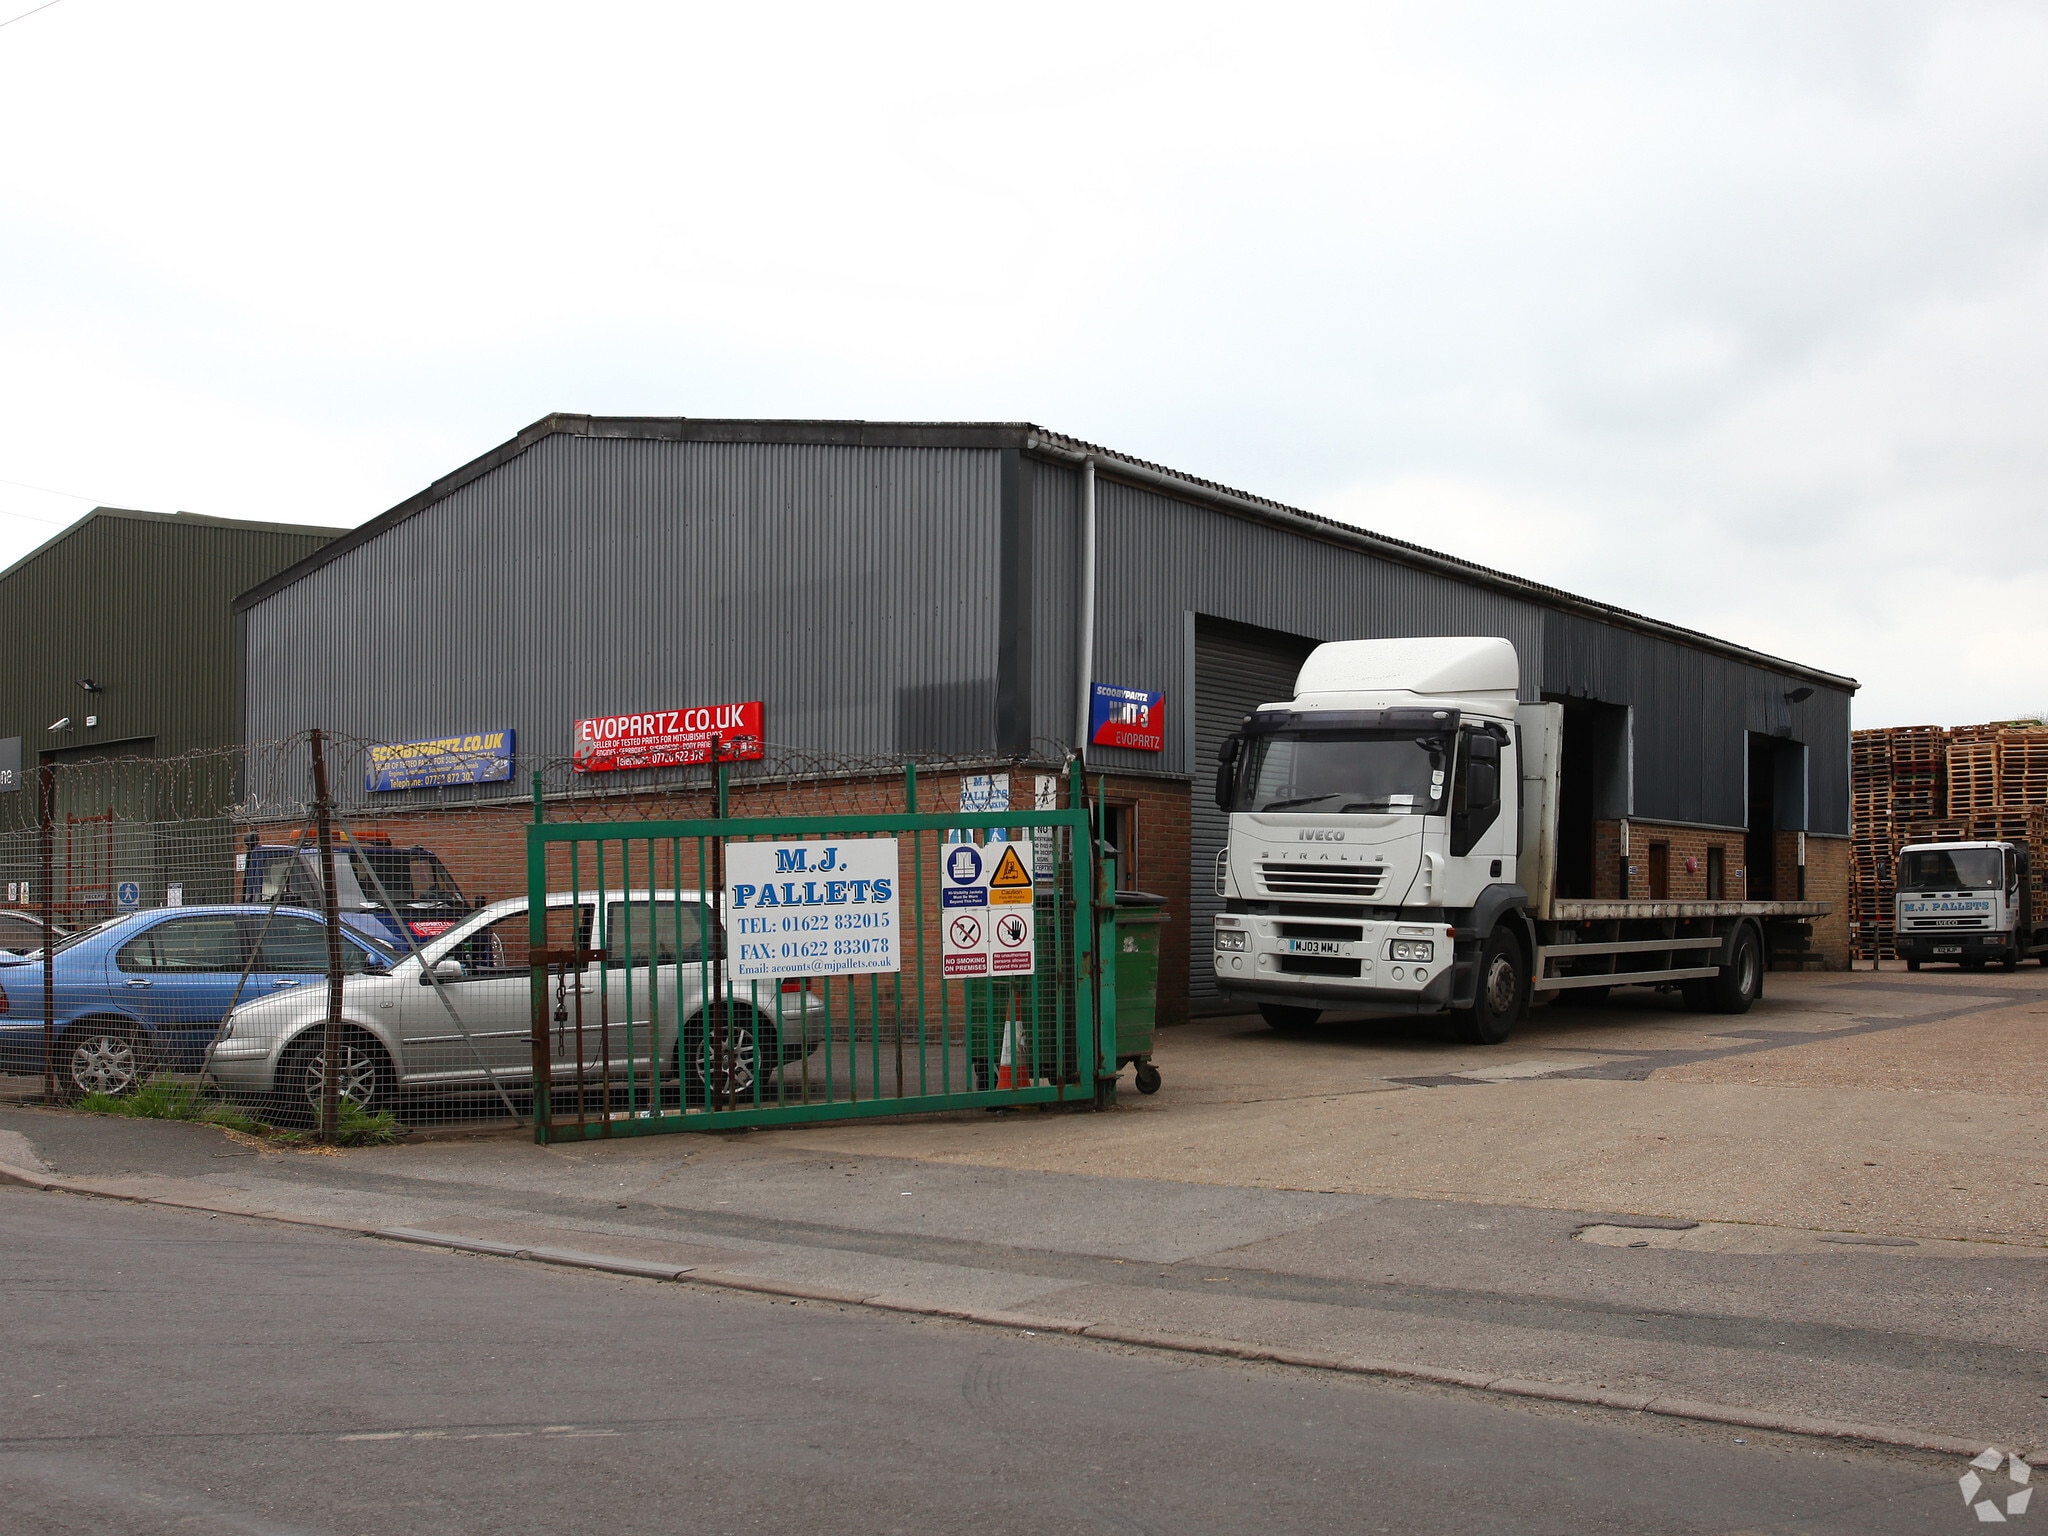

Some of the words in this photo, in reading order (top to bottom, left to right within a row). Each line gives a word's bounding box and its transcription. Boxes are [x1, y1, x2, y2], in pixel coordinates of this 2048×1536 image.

[1097, 686, 1148, 702] SCOOBYPARTZ
[582, 705, 745, 741] EVOPARTZ.CO.UK
[1109, 700, 1138, 726] UNIT
[1140, 705, 1149, 728] 3
[593, 740, 612, 749] SELLER
[612, 739, 620, 747] OF
[621, 737, 641, 747] TESTED
[641, 736, 660, 745] PARTS
[660, 734, 672, 743] FOR
[672, 732, 706, 742] MITSUBISHI
[1116, 731, 1160, 749] EVOPARTZ
[1299, 829, 1345, 841] IVECO
[775, 847, 848, 874] M.J.
[1261, 851, 1384, 862] STRALIS
[732, 878, 892, 909] PALLETS
[1904, 903, 1928, 912] M.J.
[1932, 901, 1989, 911] PALLETS
[737, 917, 777, 934] TEL:
[782, 915, 829, 932] 01622
[834, 911, 890, 930] 832015
[740, 943, 776, 960] FAX:
[781, 940, 828, 958] 01622
[833, 937, 890, 956] 833078
[739, 963, 769, 975] Email:
[771, 956, 892, 973] accounts@mjpallets.co.uk
[955, 963, 986, 971] PREMISES
